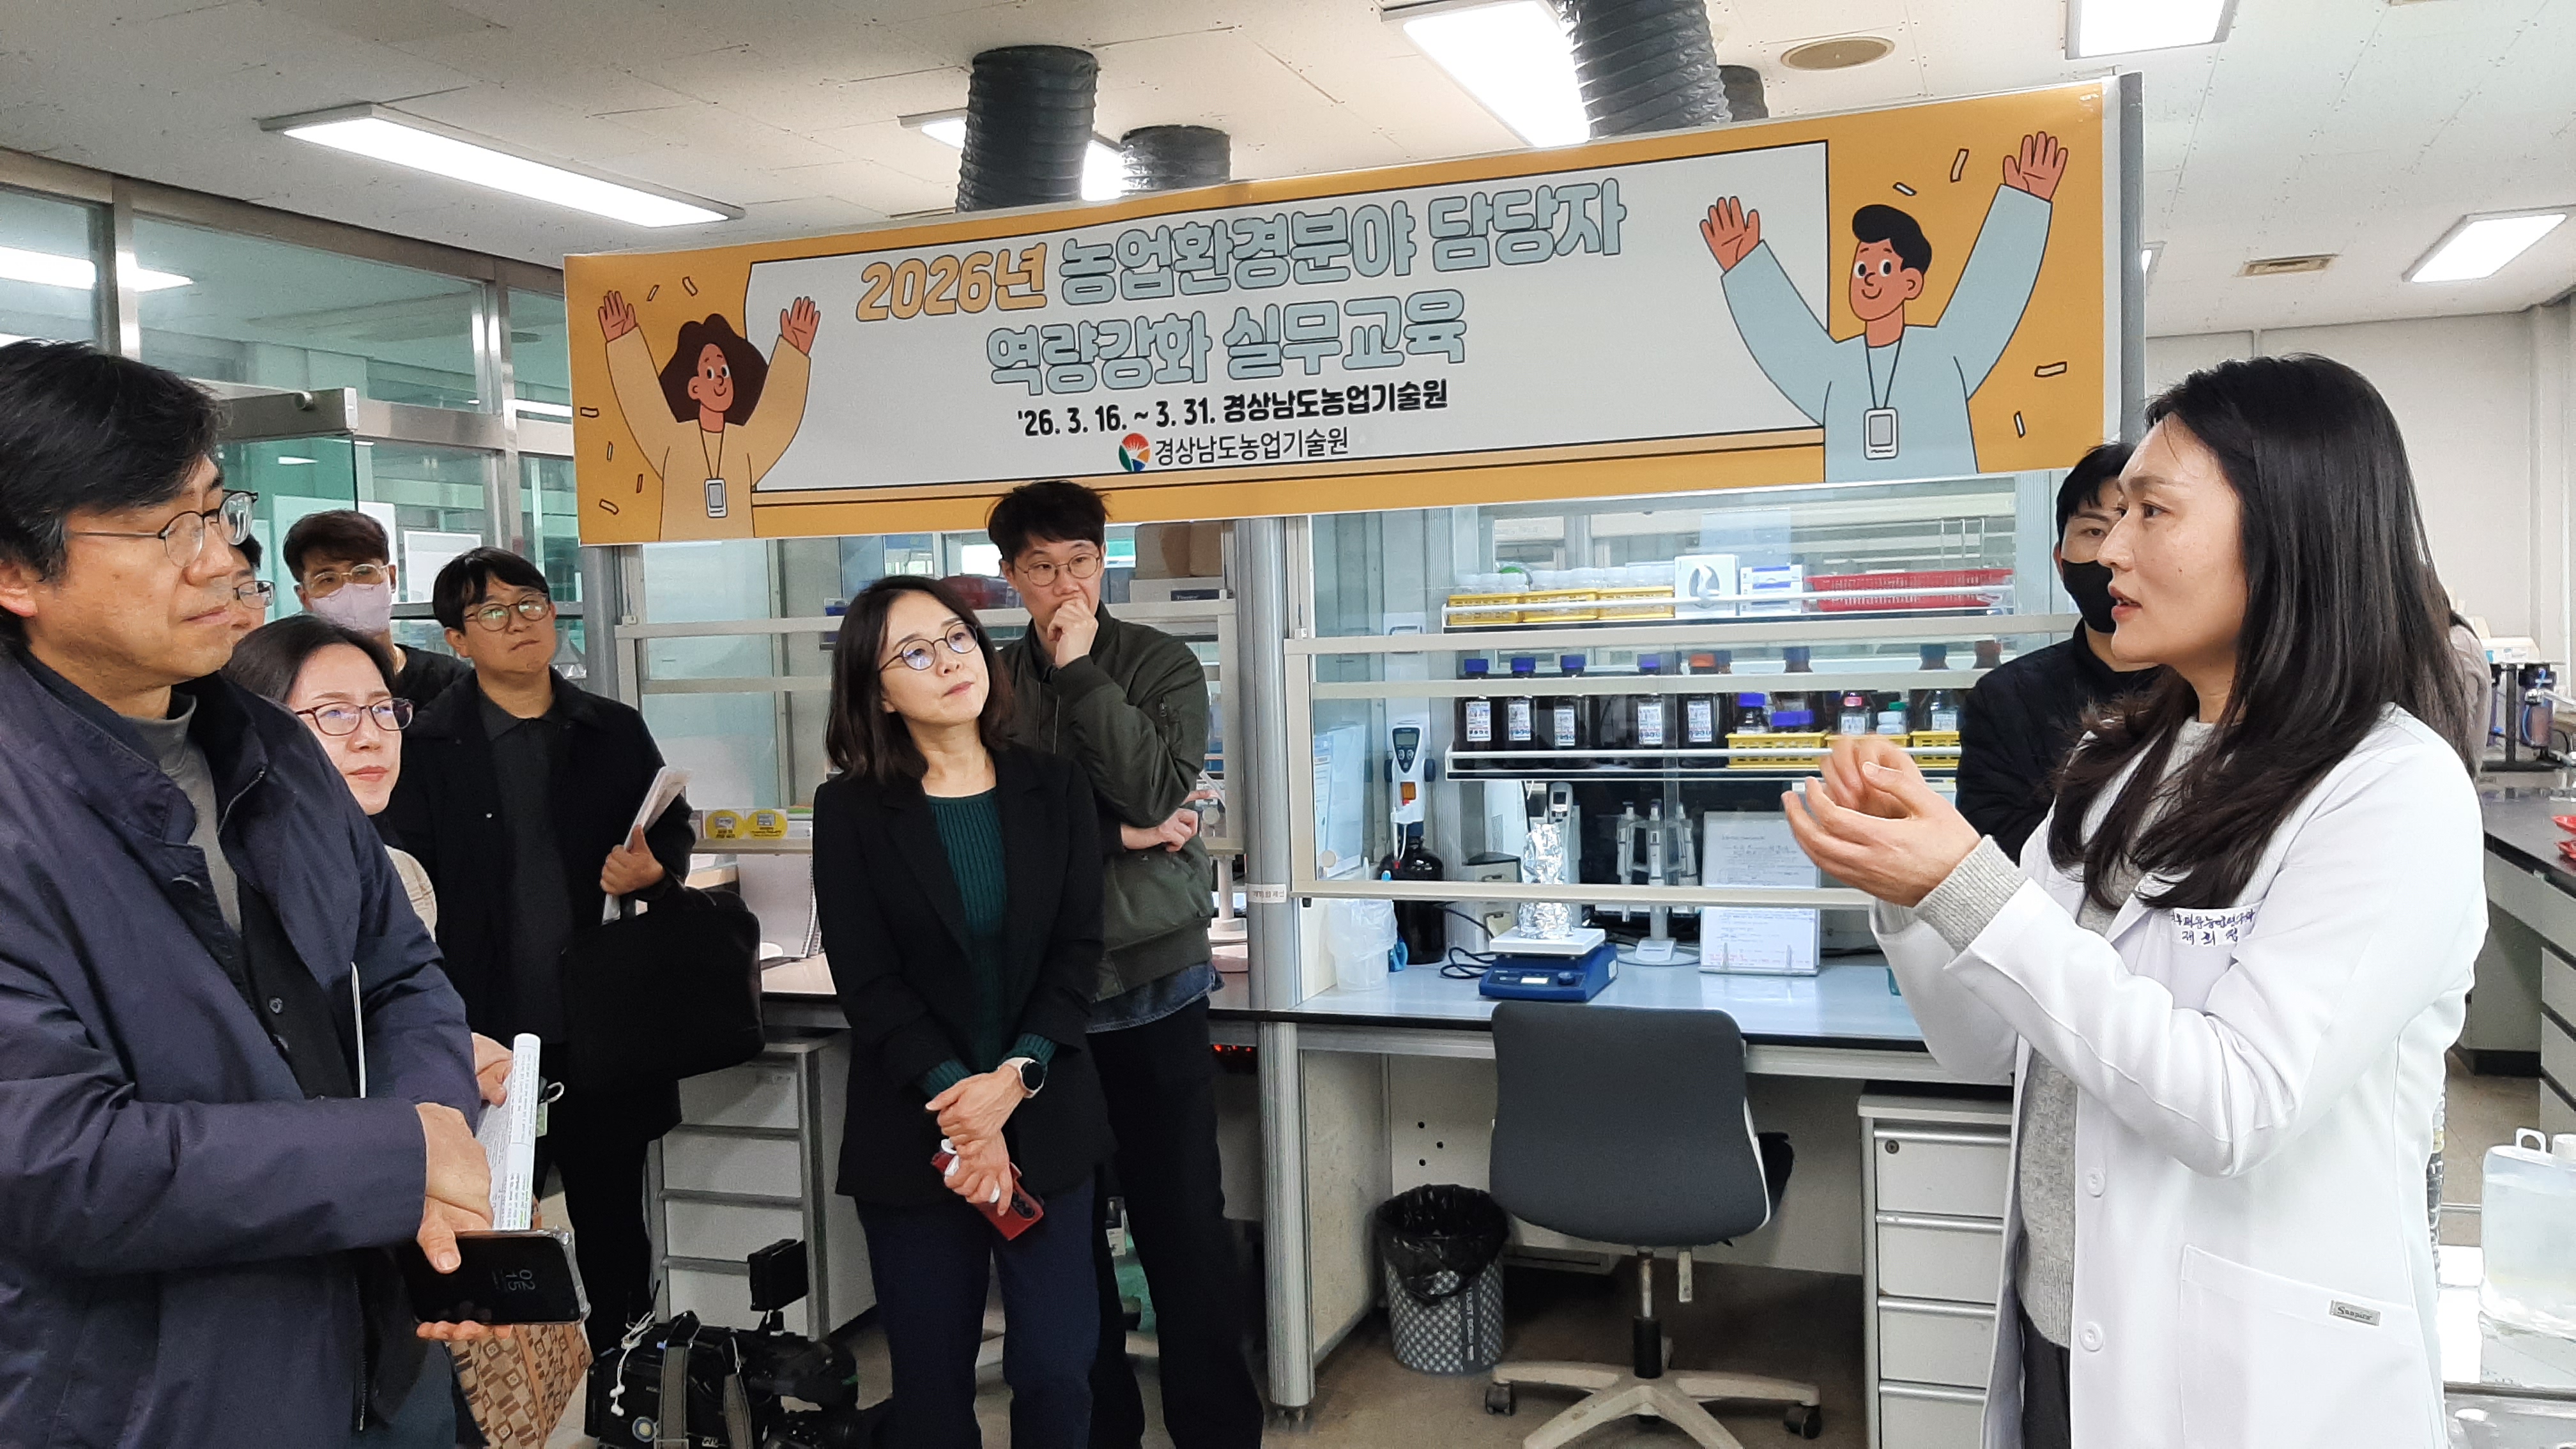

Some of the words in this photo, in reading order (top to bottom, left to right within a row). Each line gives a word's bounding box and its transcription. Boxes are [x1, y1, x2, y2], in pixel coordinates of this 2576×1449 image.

[855, 241, 1048, 322] 2026년
[1059, 199, 1417, 305] 농업환경분야
[1427, 178, 1627, 272] 담당자
[986, 310, 1213, 396] 역량강화
[1223, 288, 1468, 380] 실무교육
[1067, 407, 1089, 434] 3.
[1094, 404, 1128, 432] 16.
[1156, 400, 1177, 427] 3.
[1183, 397, 1216, 425] 31.
[1223, 378, 1448, 424] 경상남도농업기술원
[1154, 426, 1349, 466] 경상남도농업기술원
[519, 1269, 535, 1290] 02
